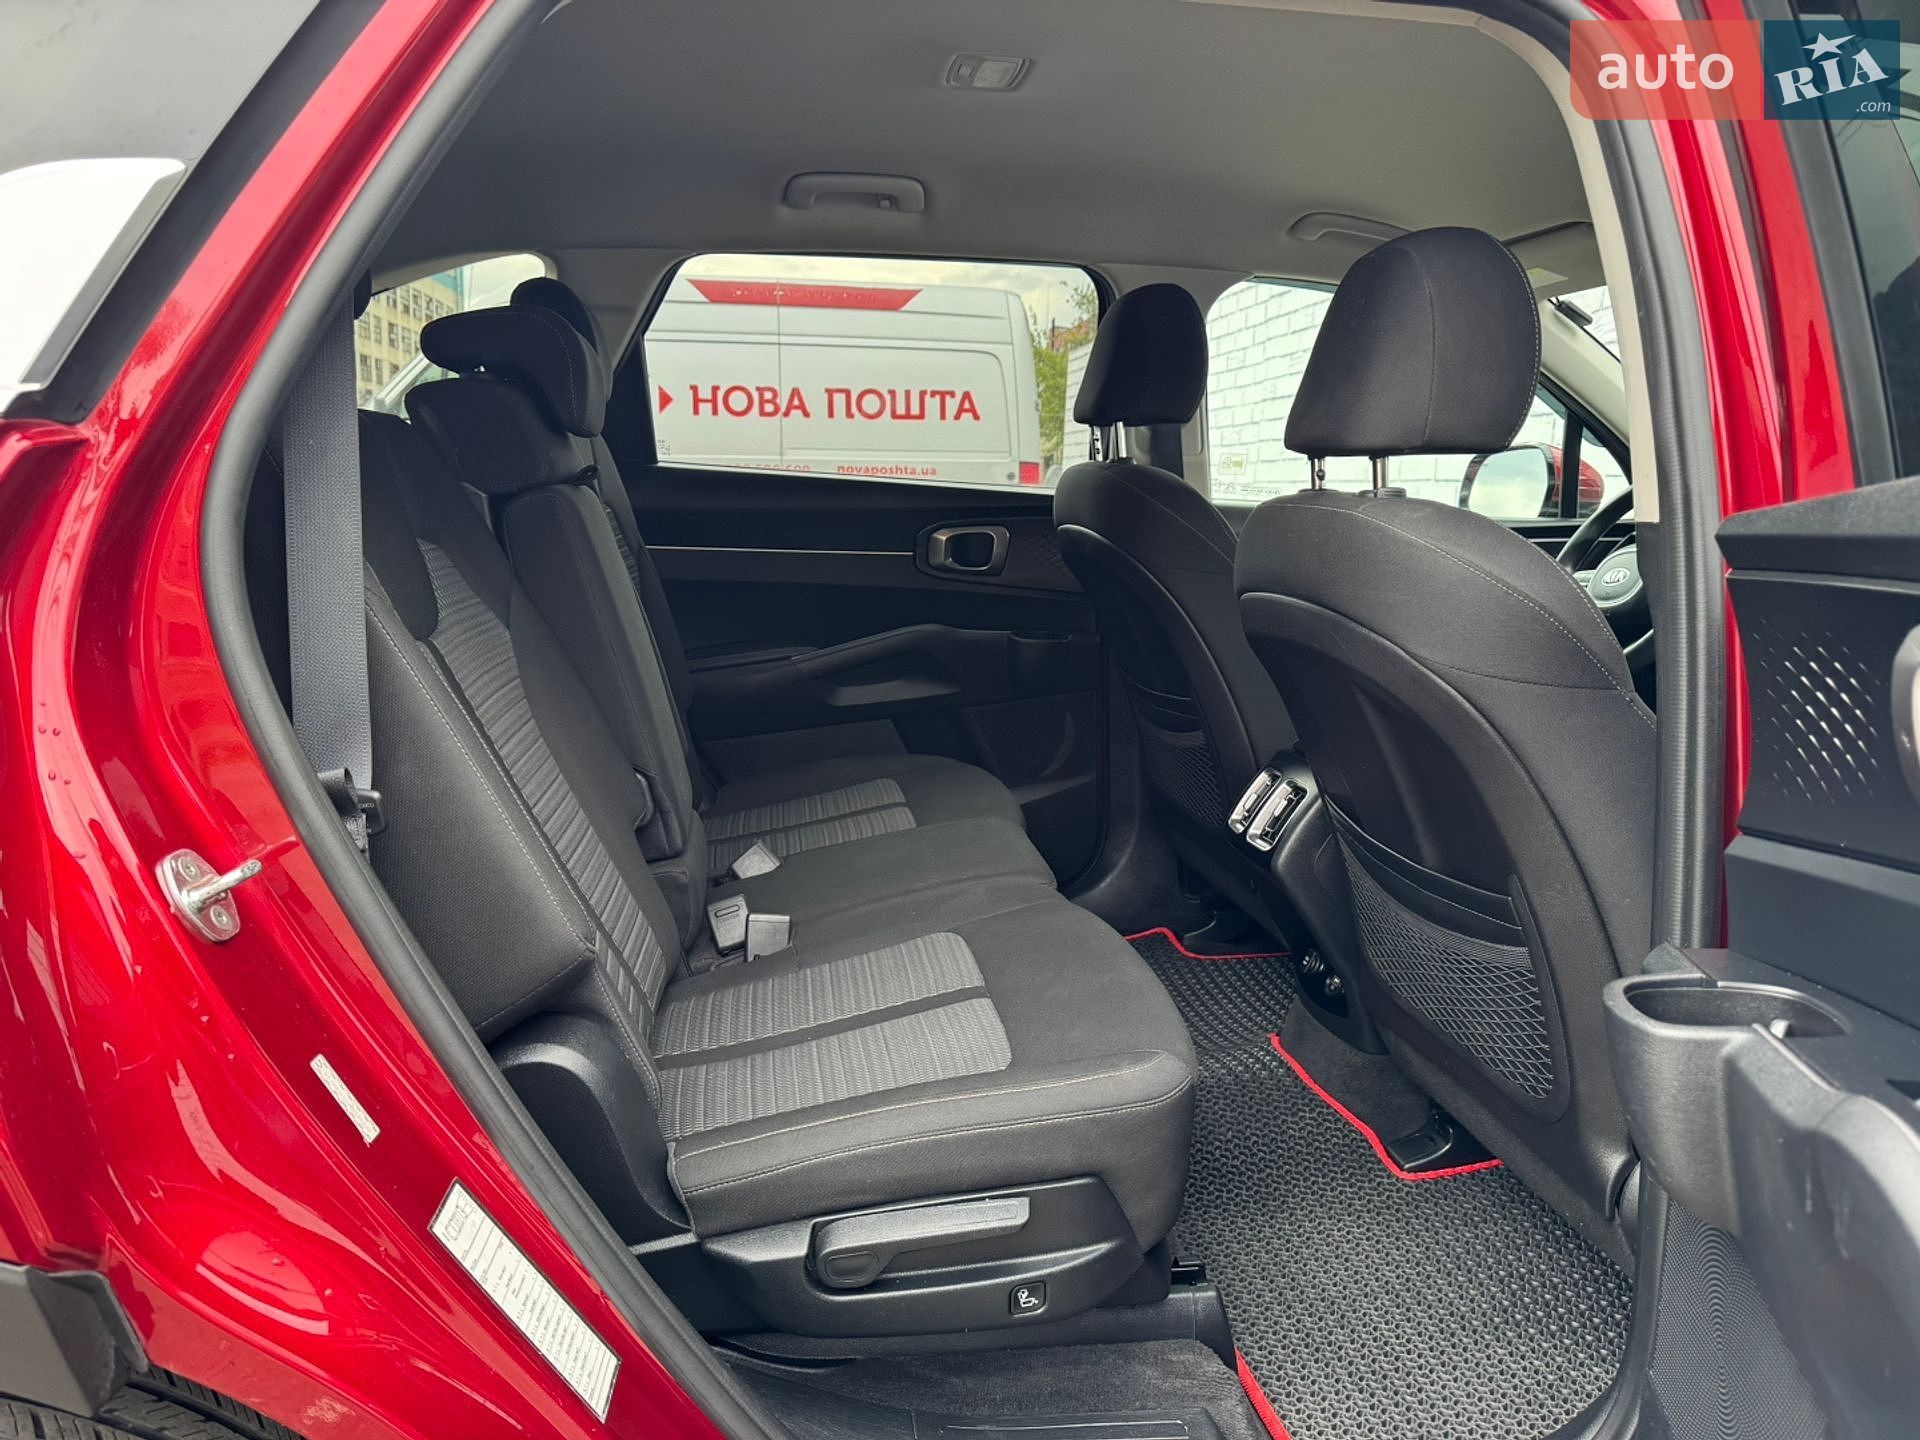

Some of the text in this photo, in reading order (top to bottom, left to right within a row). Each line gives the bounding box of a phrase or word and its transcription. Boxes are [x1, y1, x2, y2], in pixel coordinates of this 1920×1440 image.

[689, 384, 981, 421] НОВА ПОШТА
[837, 464, 938, 477] novaposhta.ua
